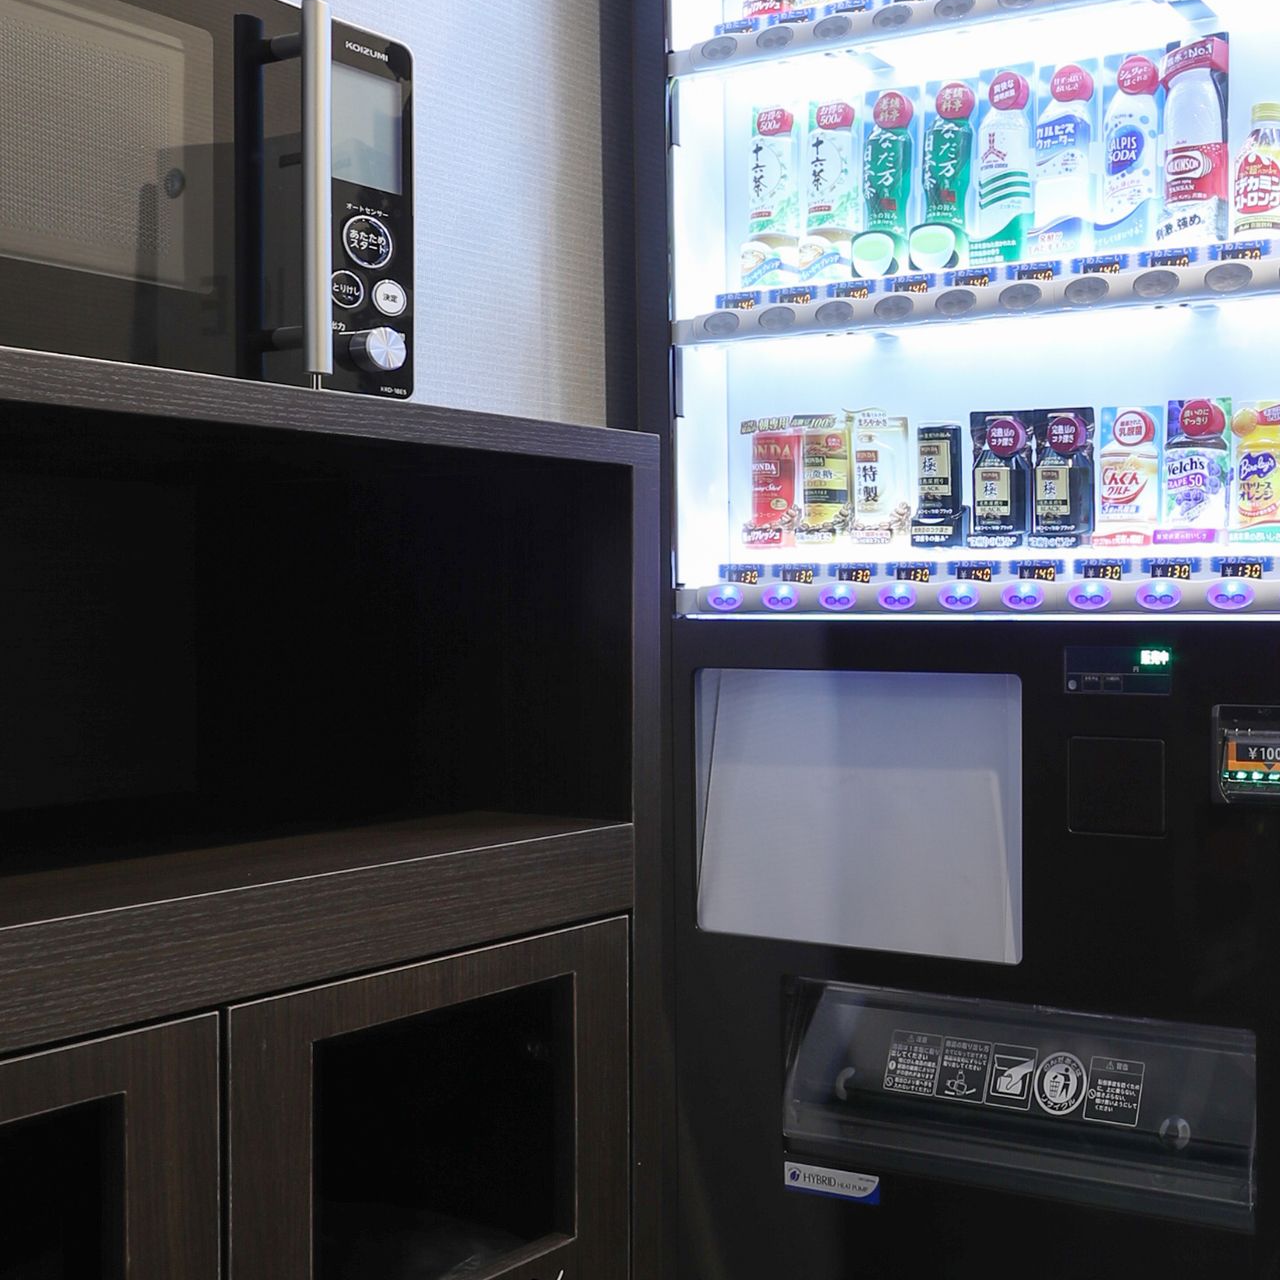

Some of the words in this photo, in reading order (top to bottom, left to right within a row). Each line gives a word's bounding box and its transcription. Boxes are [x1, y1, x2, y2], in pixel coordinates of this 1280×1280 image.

[345, 40, 389, 62] KOIZUMI
[1036, 124, 1075, 139] カルピス
[752, 144, 768, 198] 十六茶
[811, 136, 828, 192] 十六茶
[346, 202, 389, 218] オートセンサー
[349, 229, 386, 246] あたため
[350, 238, 388, 254] スタート
[332, 282, 360, 296] とりけし
[1119, 426, 1143, 437] 乳酸菌
[922, 456, 938, 476] 極
[862, 465, 878, 503] 特製
[983, 480, 998, 498] 極
[1043, 480, 1057, 497] 極
[1189, 475, 1203, 487] 50
[1239, 481, 1272, 491] バヤリース
[1239, 491, 1274, 502] オレンジ
[803, 1172, 837, 1187] HYBRID
